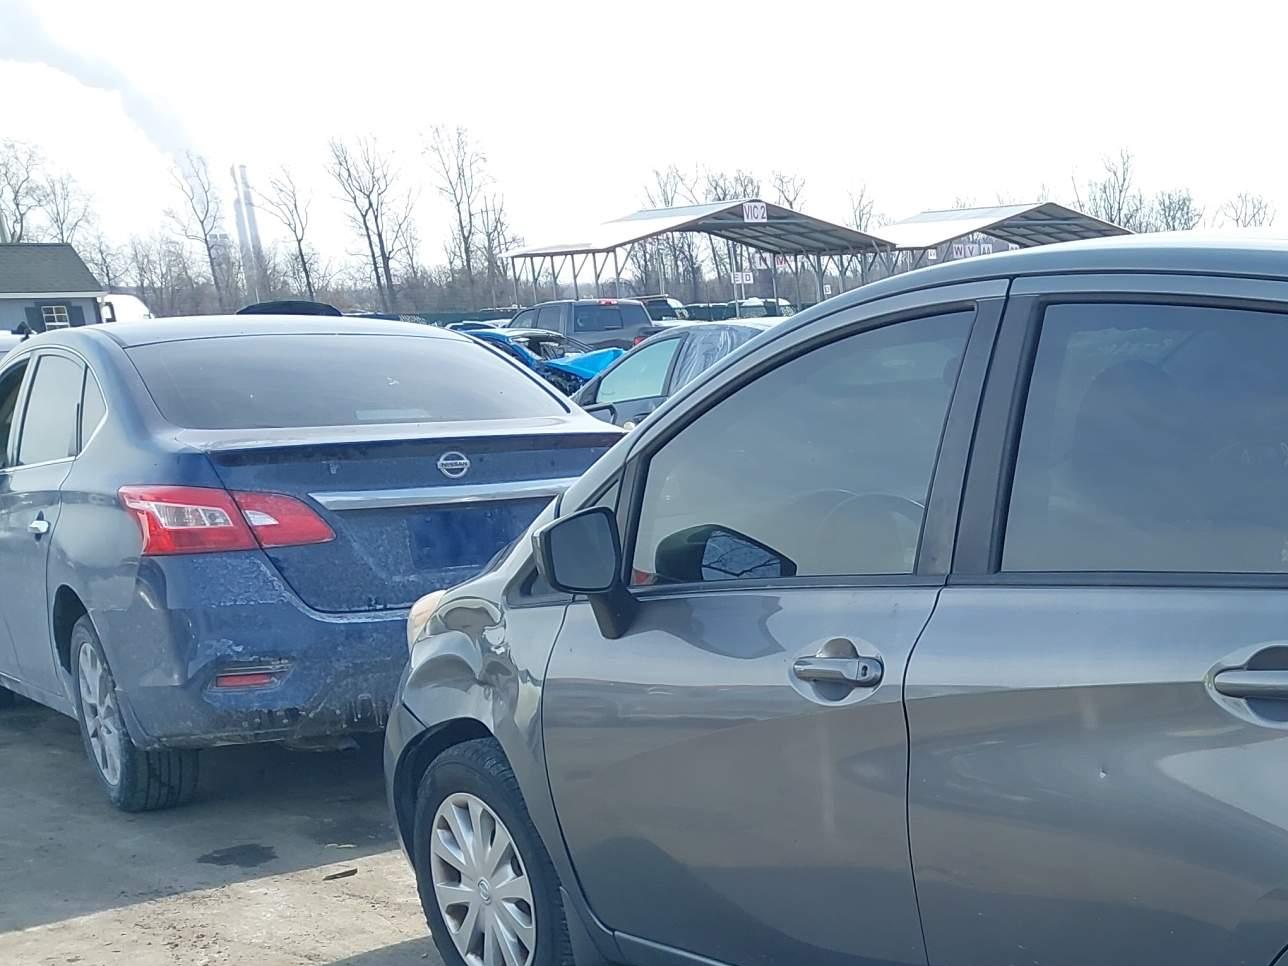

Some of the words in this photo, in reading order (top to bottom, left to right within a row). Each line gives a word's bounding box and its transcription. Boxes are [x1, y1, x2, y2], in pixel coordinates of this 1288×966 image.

[744, 206, 759, 219] VIC
[761, 206, 766, 219] 2
[954, 246, 964, 257] W
